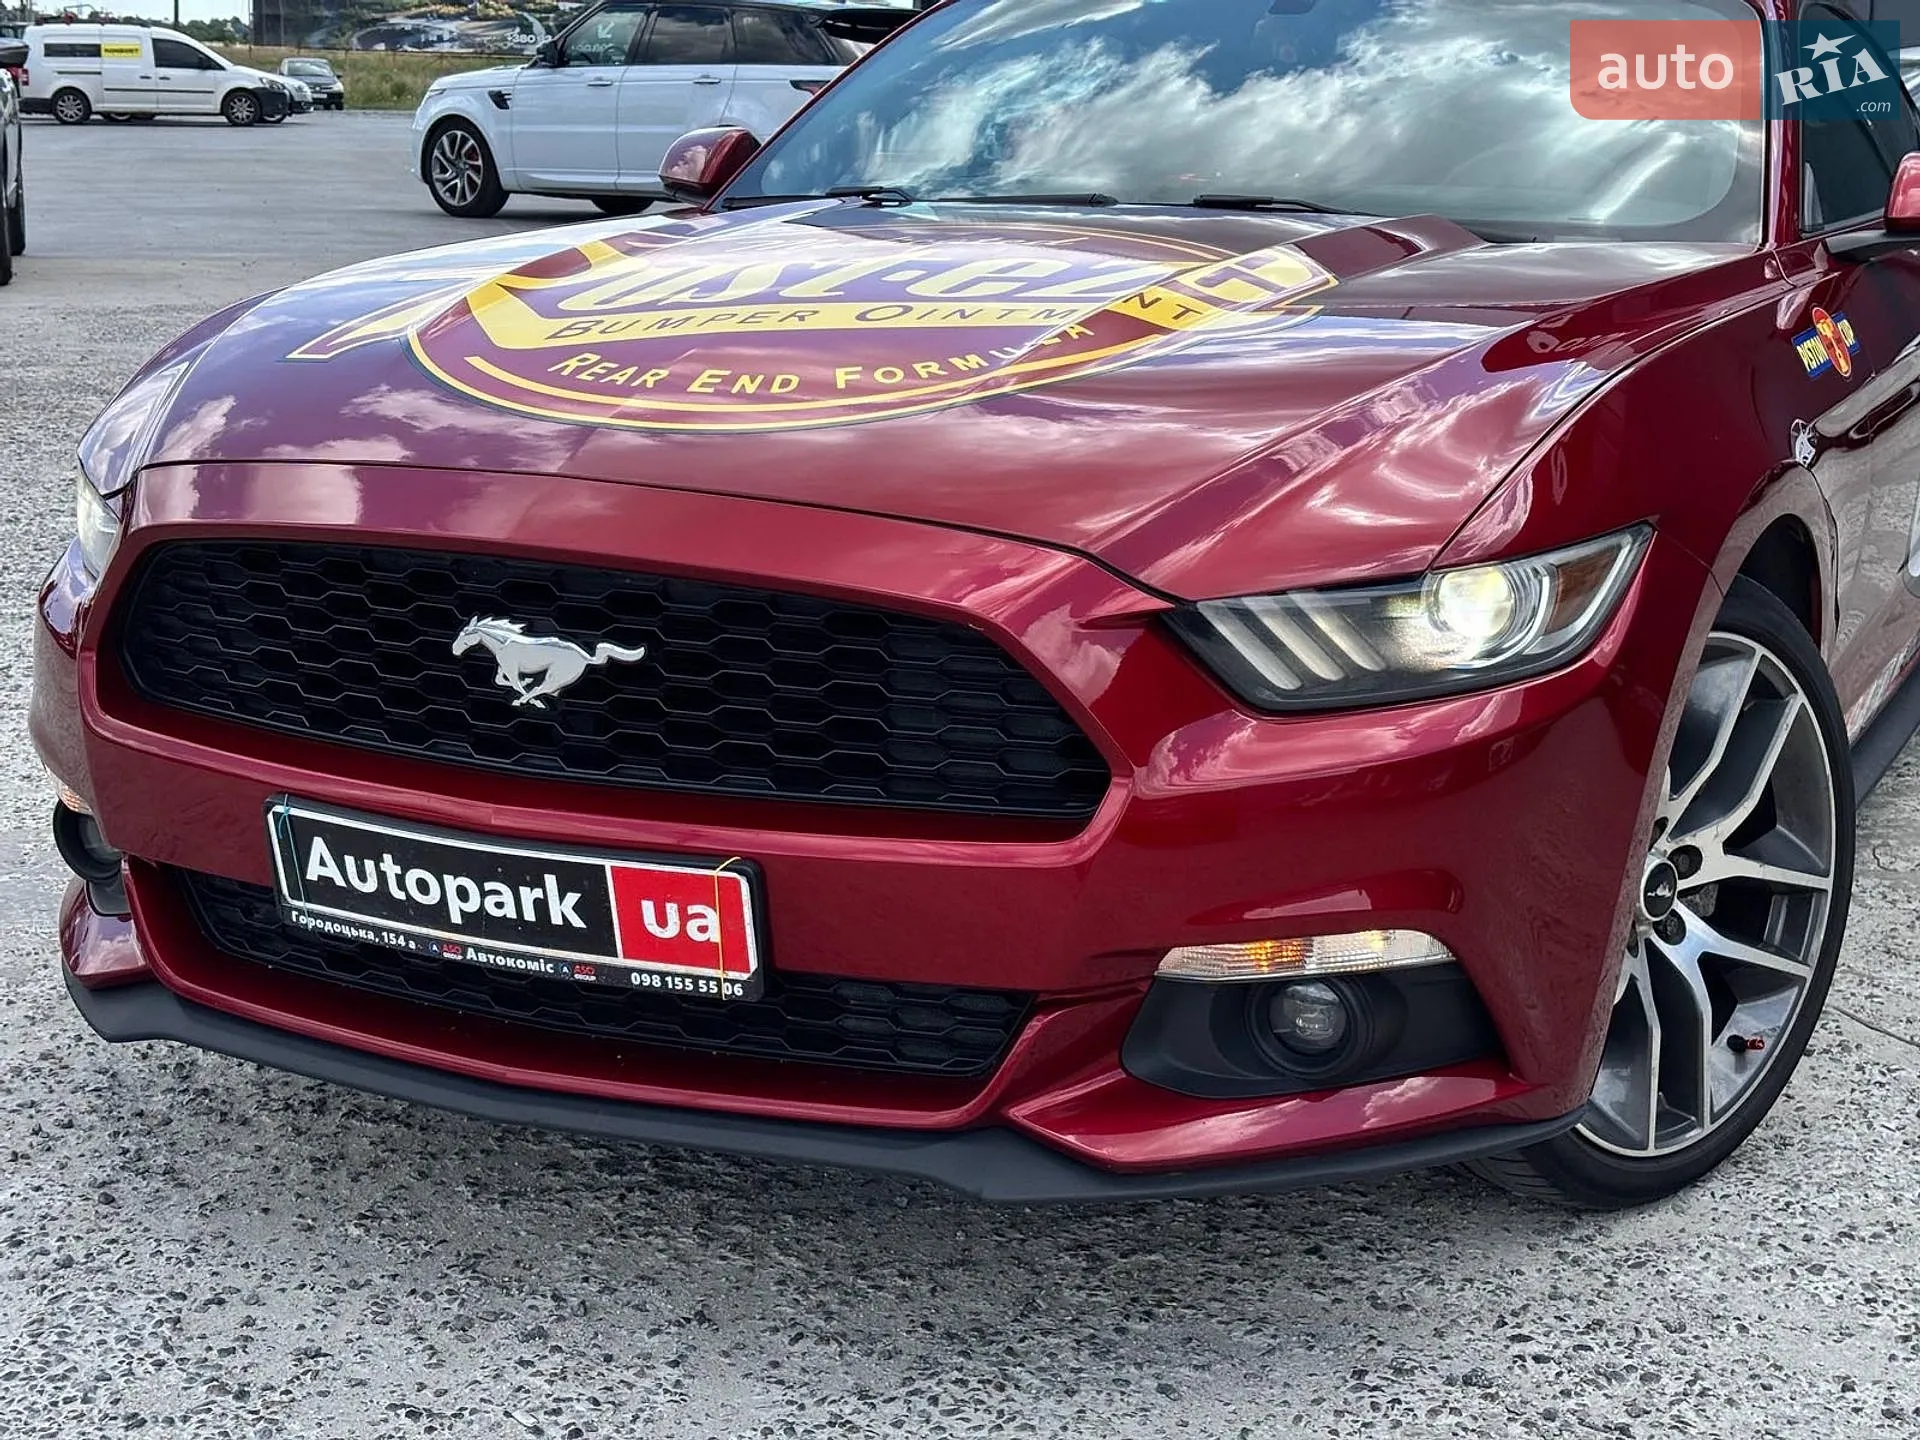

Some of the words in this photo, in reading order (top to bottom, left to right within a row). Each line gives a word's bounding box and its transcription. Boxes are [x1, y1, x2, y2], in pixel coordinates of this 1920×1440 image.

[545, 310, 820, 340] BUMPER
[547, 352, 670, 388] REAR
[686, 369, 800, 395] END
[305, 836, 587, 929] Autopark
[640, 899, 720, 943] ua
[291, 910, 380, 943] Городоцька,
[381, 931, 406, 948] 154
[466, 947, 555, 974] Автокоміс
[630, 972, 662, 988] 098
[664, 975, 694, 991] 155
[698, 980, 718, 994] 55
[724, 984, 744, 996] 06
